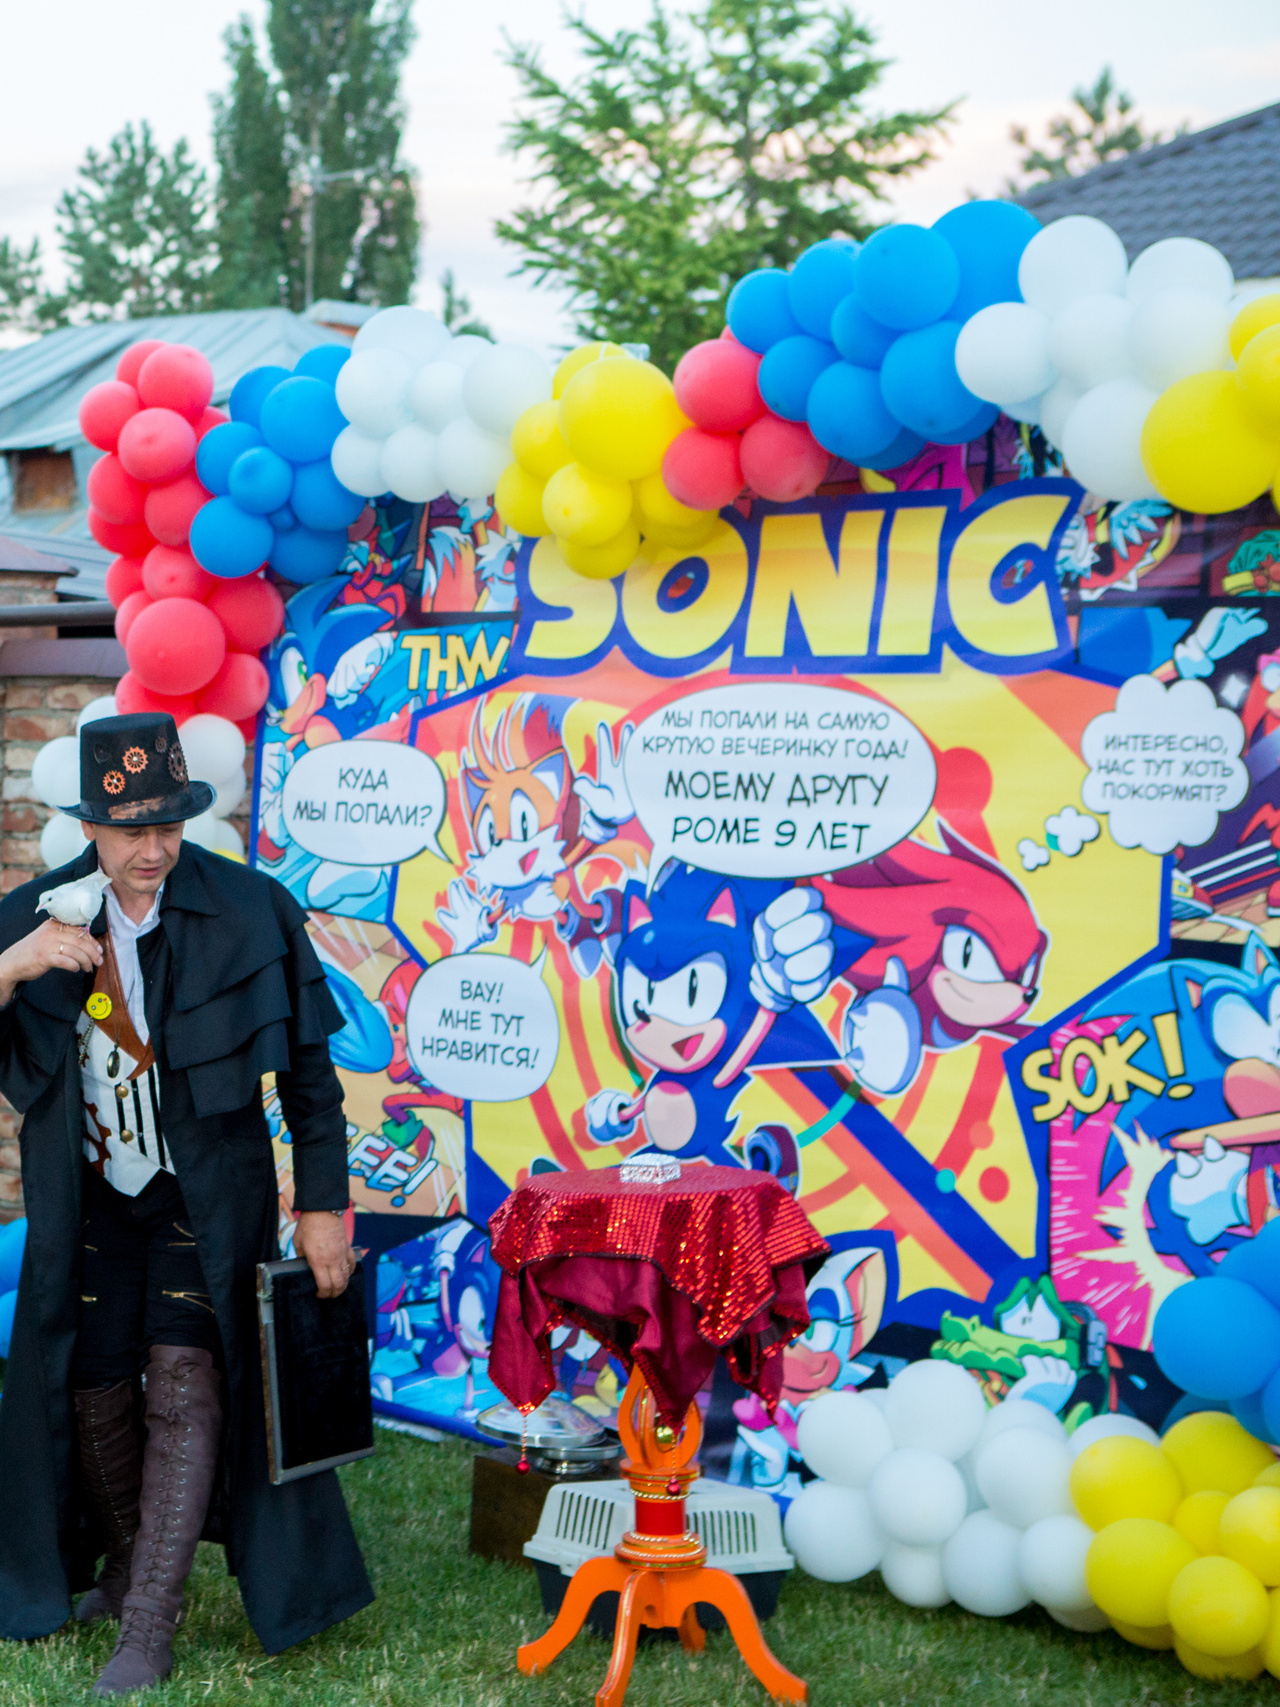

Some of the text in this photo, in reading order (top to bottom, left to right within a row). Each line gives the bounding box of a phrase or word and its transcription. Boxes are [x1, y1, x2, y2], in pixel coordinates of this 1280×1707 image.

[524, 495, 1072, 660] SONIC
[661, 710, 890, 731] МЫ ПОПАЛИ НА САМУЮ
[642, 736, 909, 760] КРУТУЮ ВЕЧЕРИНКУ ГОДА!
[1104, 734, 1228, 756] ИНТЕРЕСНО,
[338, 767, 389, 792] КУДА
[1097, 759, 1234, 778] НАС ТУТ ХОТЬ
[665, 770, 889, 807] МОЕМУ ДРУГУ
[1102, 782, 1228, 802] ПОКОРМЯТ?
[293, 801, 433, 827] МЫ ПОПАЛИ?
[671, 816, 870, 854] РОМЕ 9 ЛЕТ
[460, 980, 503, 1004] ВАУ!
[438, 1008, 525, 1037] МНЕ ТУТ
[421, 1036, 539, 1069] НРАВИТСЯ!
[1021, 1010, 1194, 1123] SOK!
